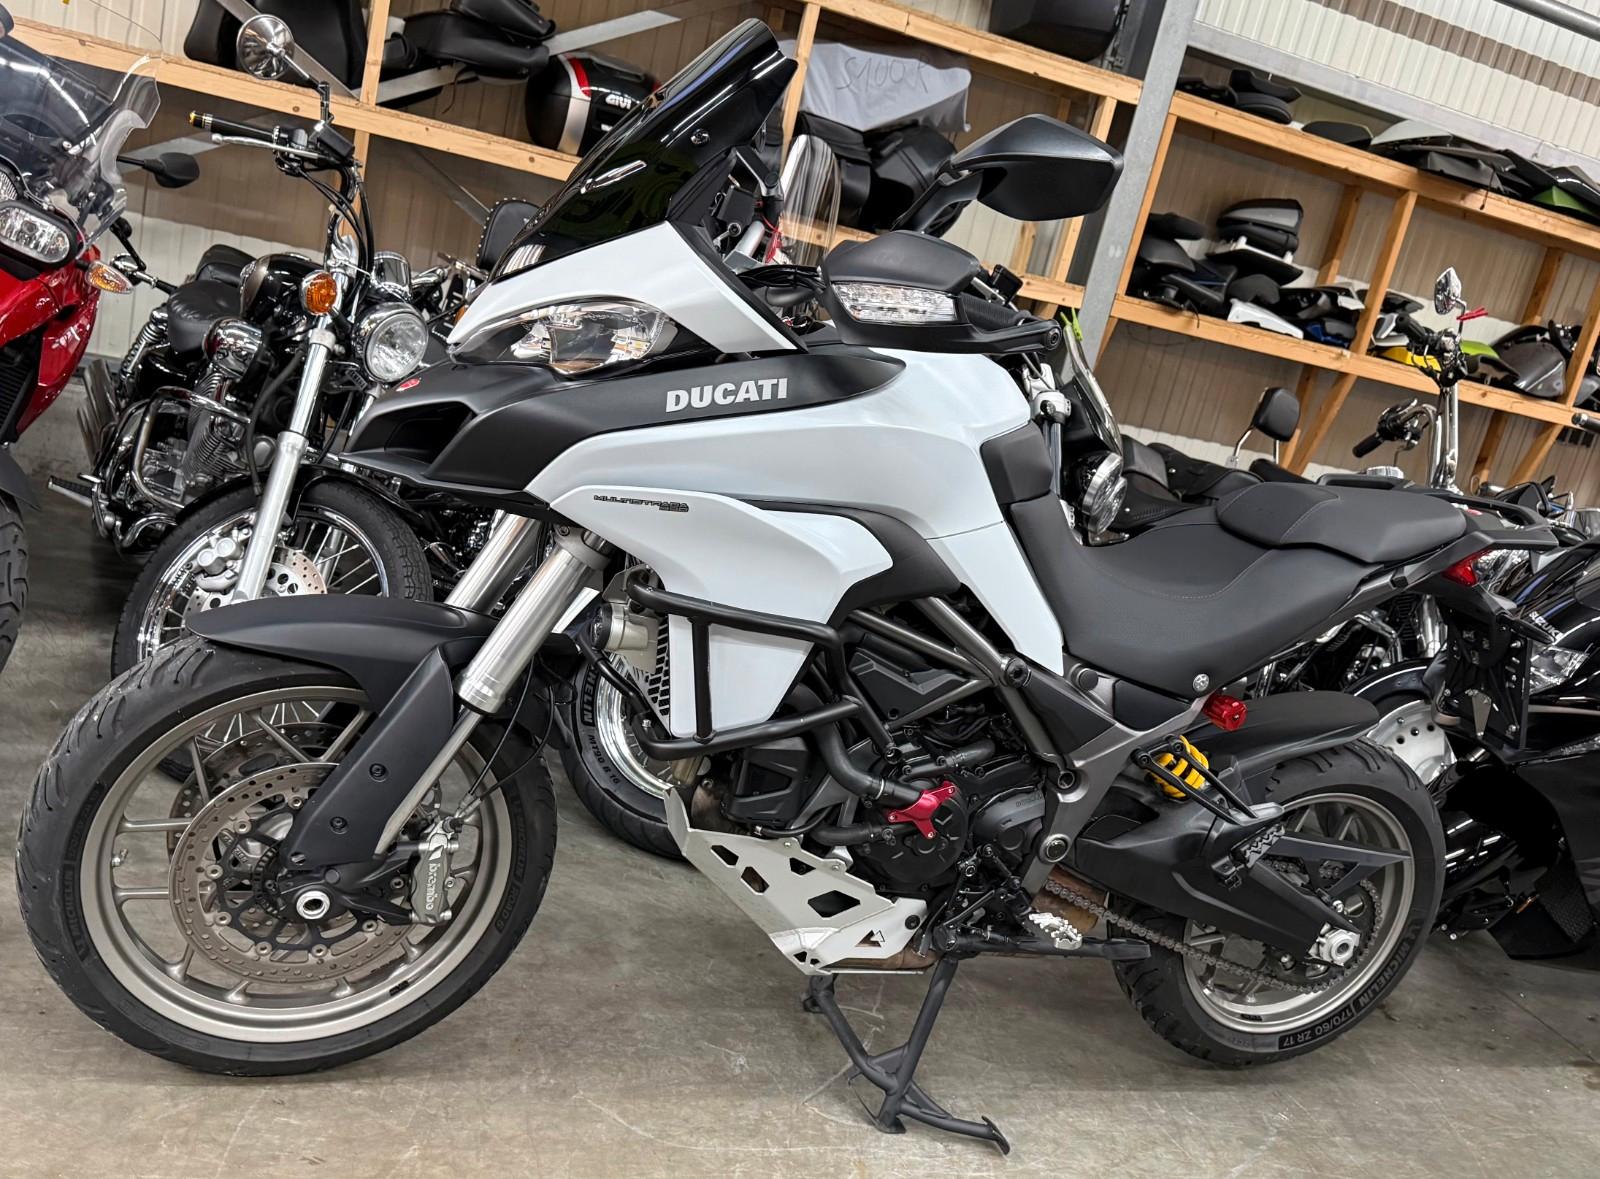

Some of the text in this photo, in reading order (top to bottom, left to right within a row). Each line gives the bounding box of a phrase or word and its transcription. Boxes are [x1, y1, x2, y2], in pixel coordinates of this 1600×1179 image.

[605, 93, 632, 110] GIVI
[665, 377, 788, 413] DUCATI
[1529, 610, 1564, 641] SUZUKI
[583, 667, 599, 723] HELIN
[425, 862, 441, 911] brembo
[1359, 939, 1411, 1006] MICHELIN
[1283, 1008, 1354, 1048] 170/60 ZR 17
